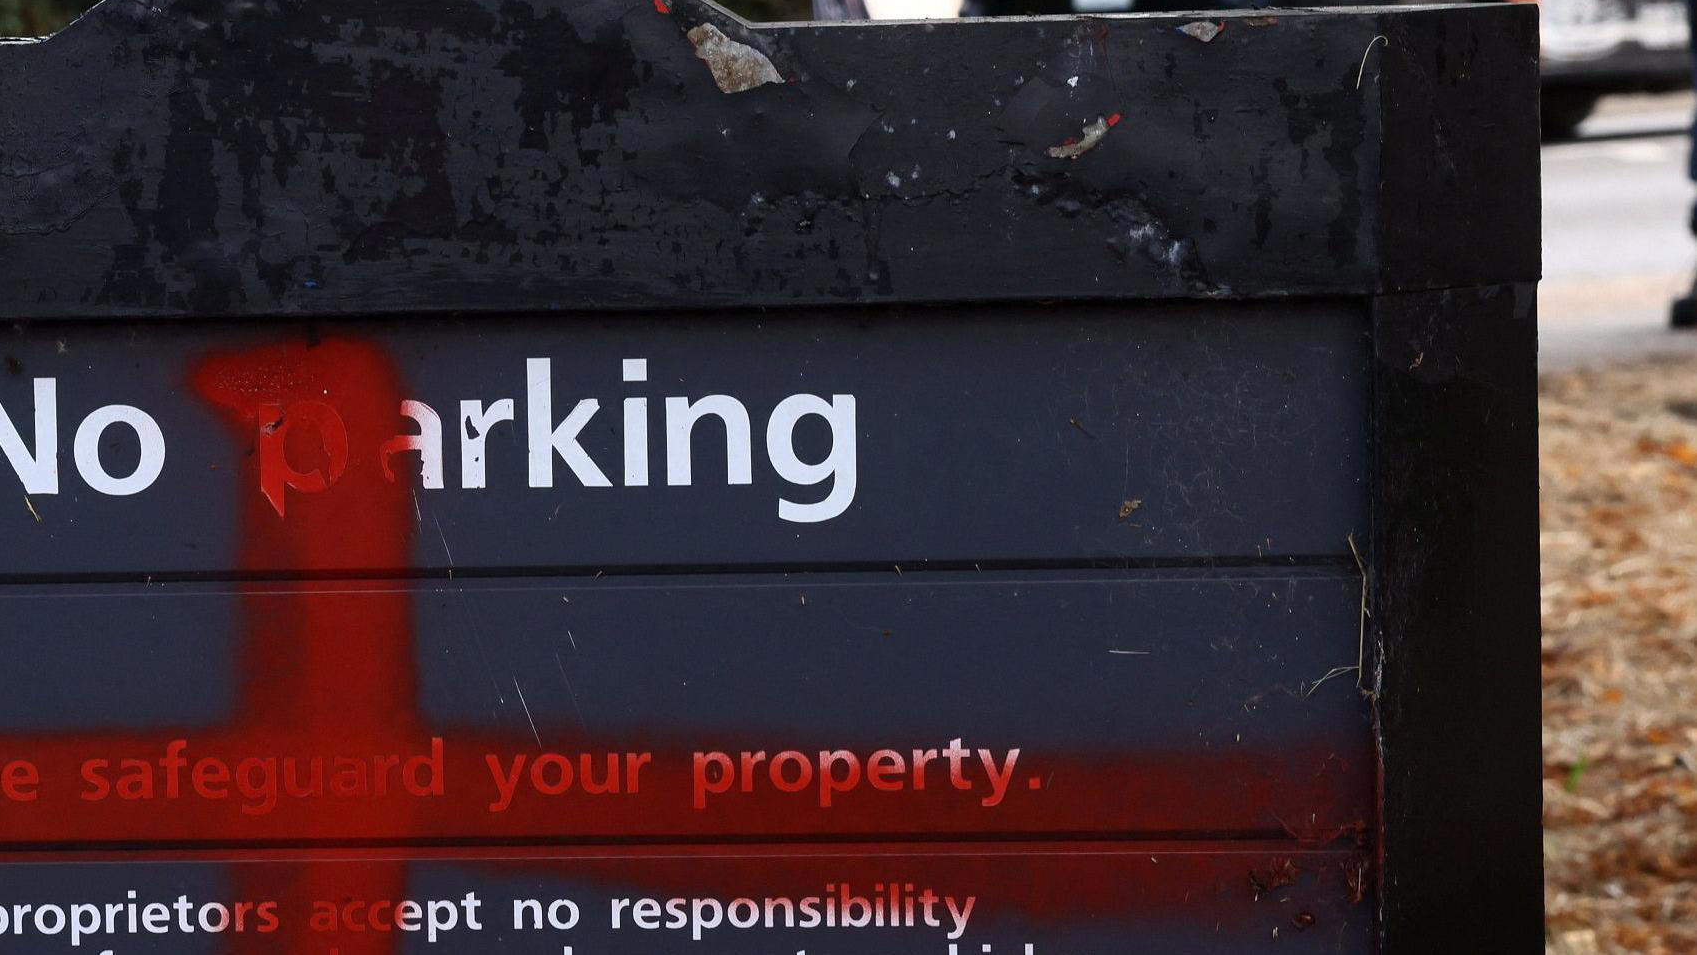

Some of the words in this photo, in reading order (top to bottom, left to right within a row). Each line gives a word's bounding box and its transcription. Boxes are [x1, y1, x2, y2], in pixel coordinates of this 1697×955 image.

[259, 357, 857, 523] parking
[81, 736, 444, 815] safeguard
[485, 748, 652, 812] your
[692, 737, 1042, 809] property.
[309, 891, 482, 942] accept
[512, 897, 580, 931] no
[610, 883, 976, 941] responsibility
